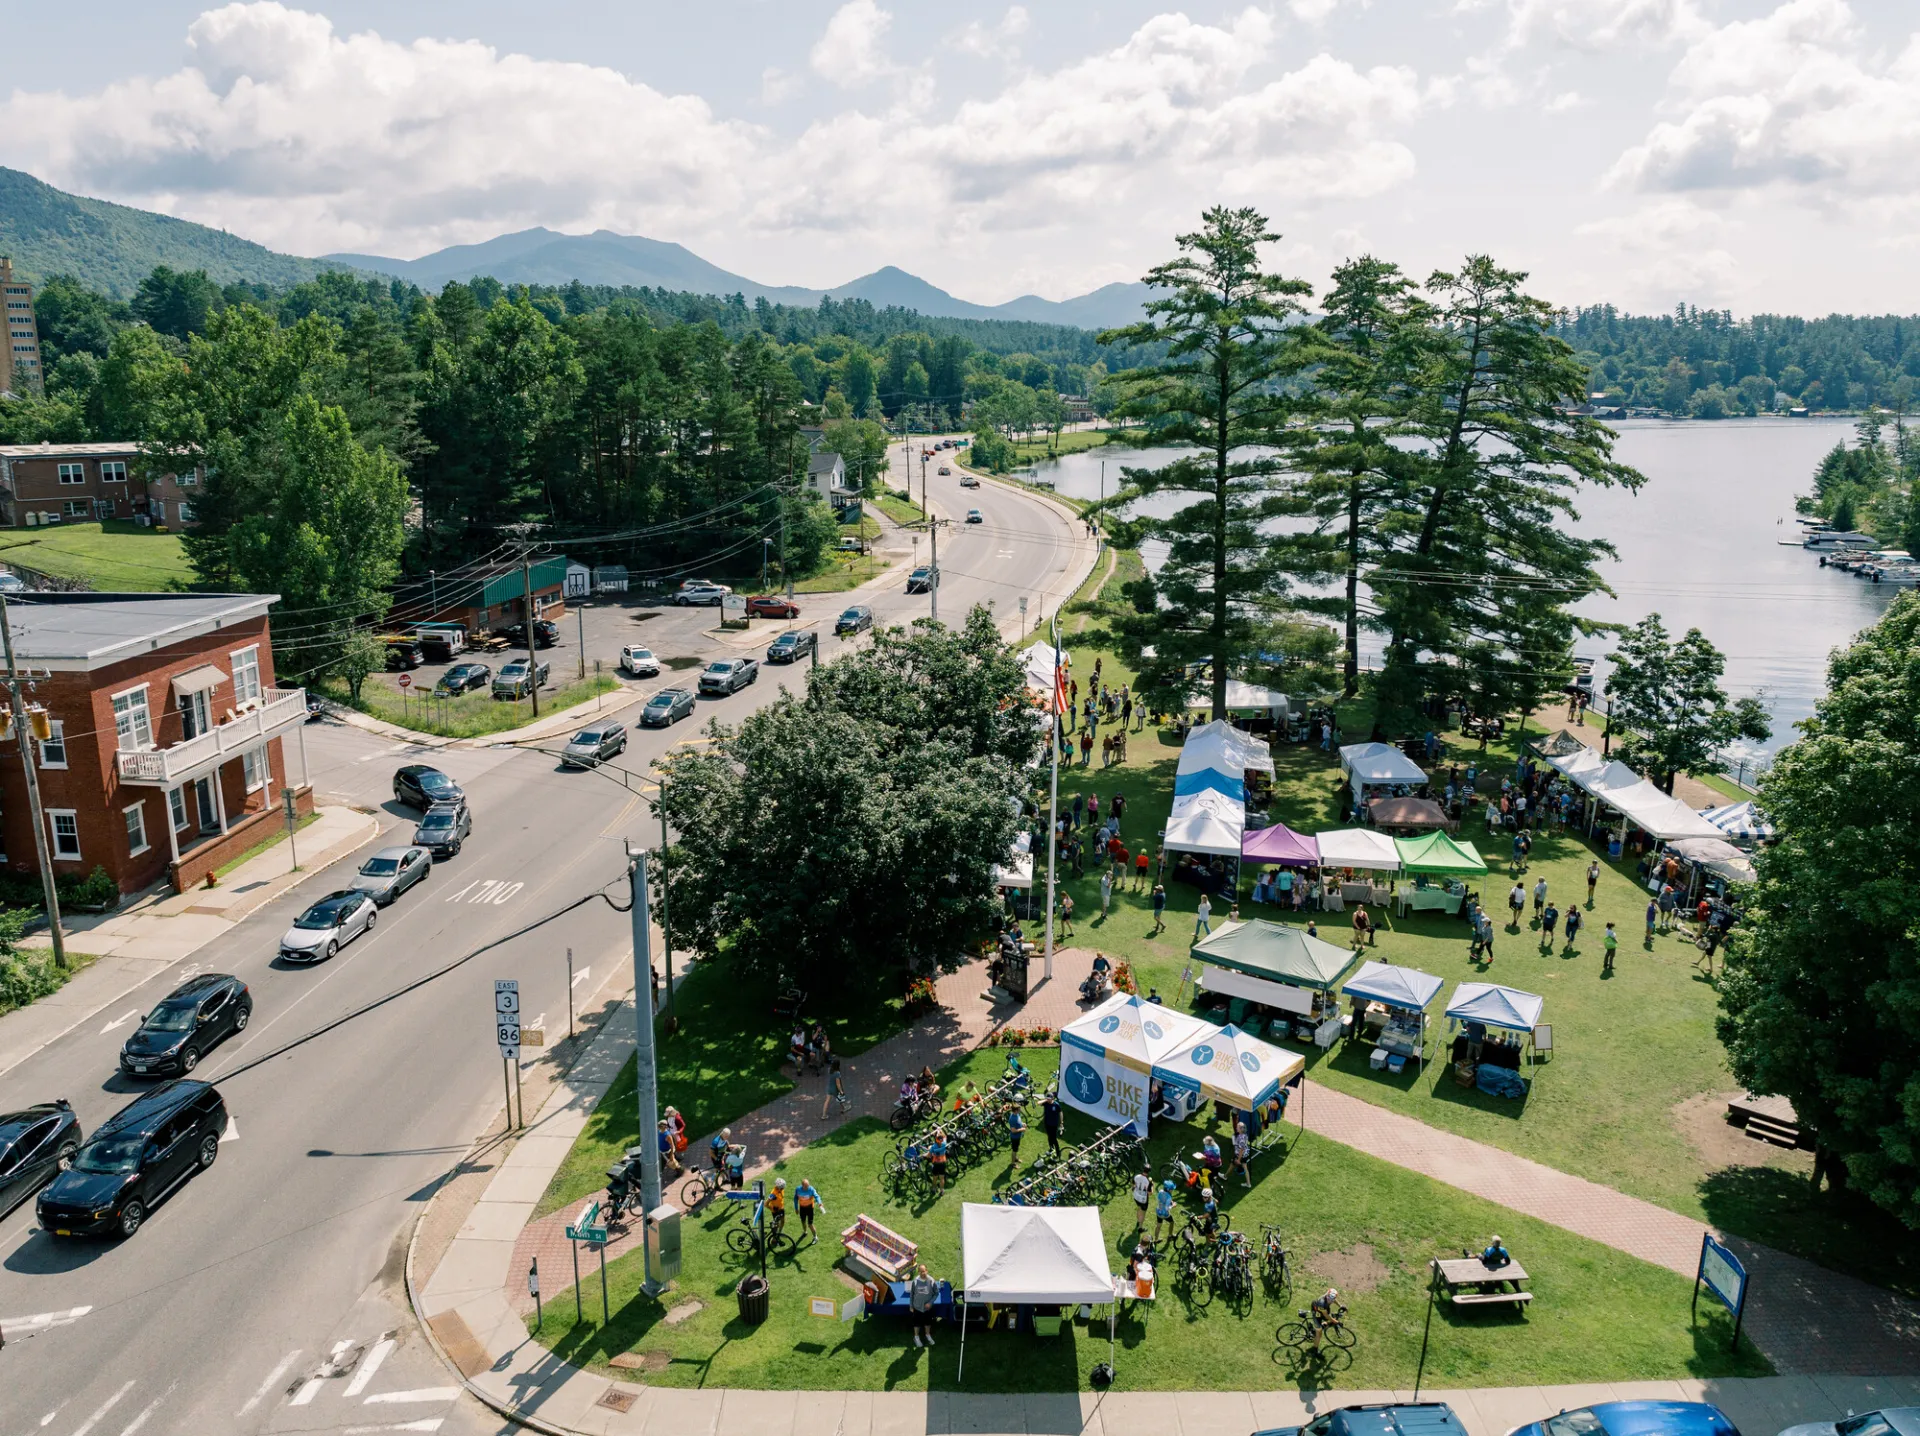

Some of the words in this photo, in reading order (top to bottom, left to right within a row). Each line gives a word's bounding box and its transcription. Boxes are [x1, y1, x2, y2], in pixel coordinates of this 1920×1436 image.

[445, 880, 524, 904] ONLY
[504, 996, 512, 1008] 3
[500, 1029, 518, 1041] 86
[1121, 1020, 1140, 1035] BIKE
[1215, 1051, 1236, 1066] BIKE
[1212, 1061, 1232, 1073] ADK
[1106, 1075, 1143, 1106] BIKE
[1107, 1095, 1141, 1122] ADK
